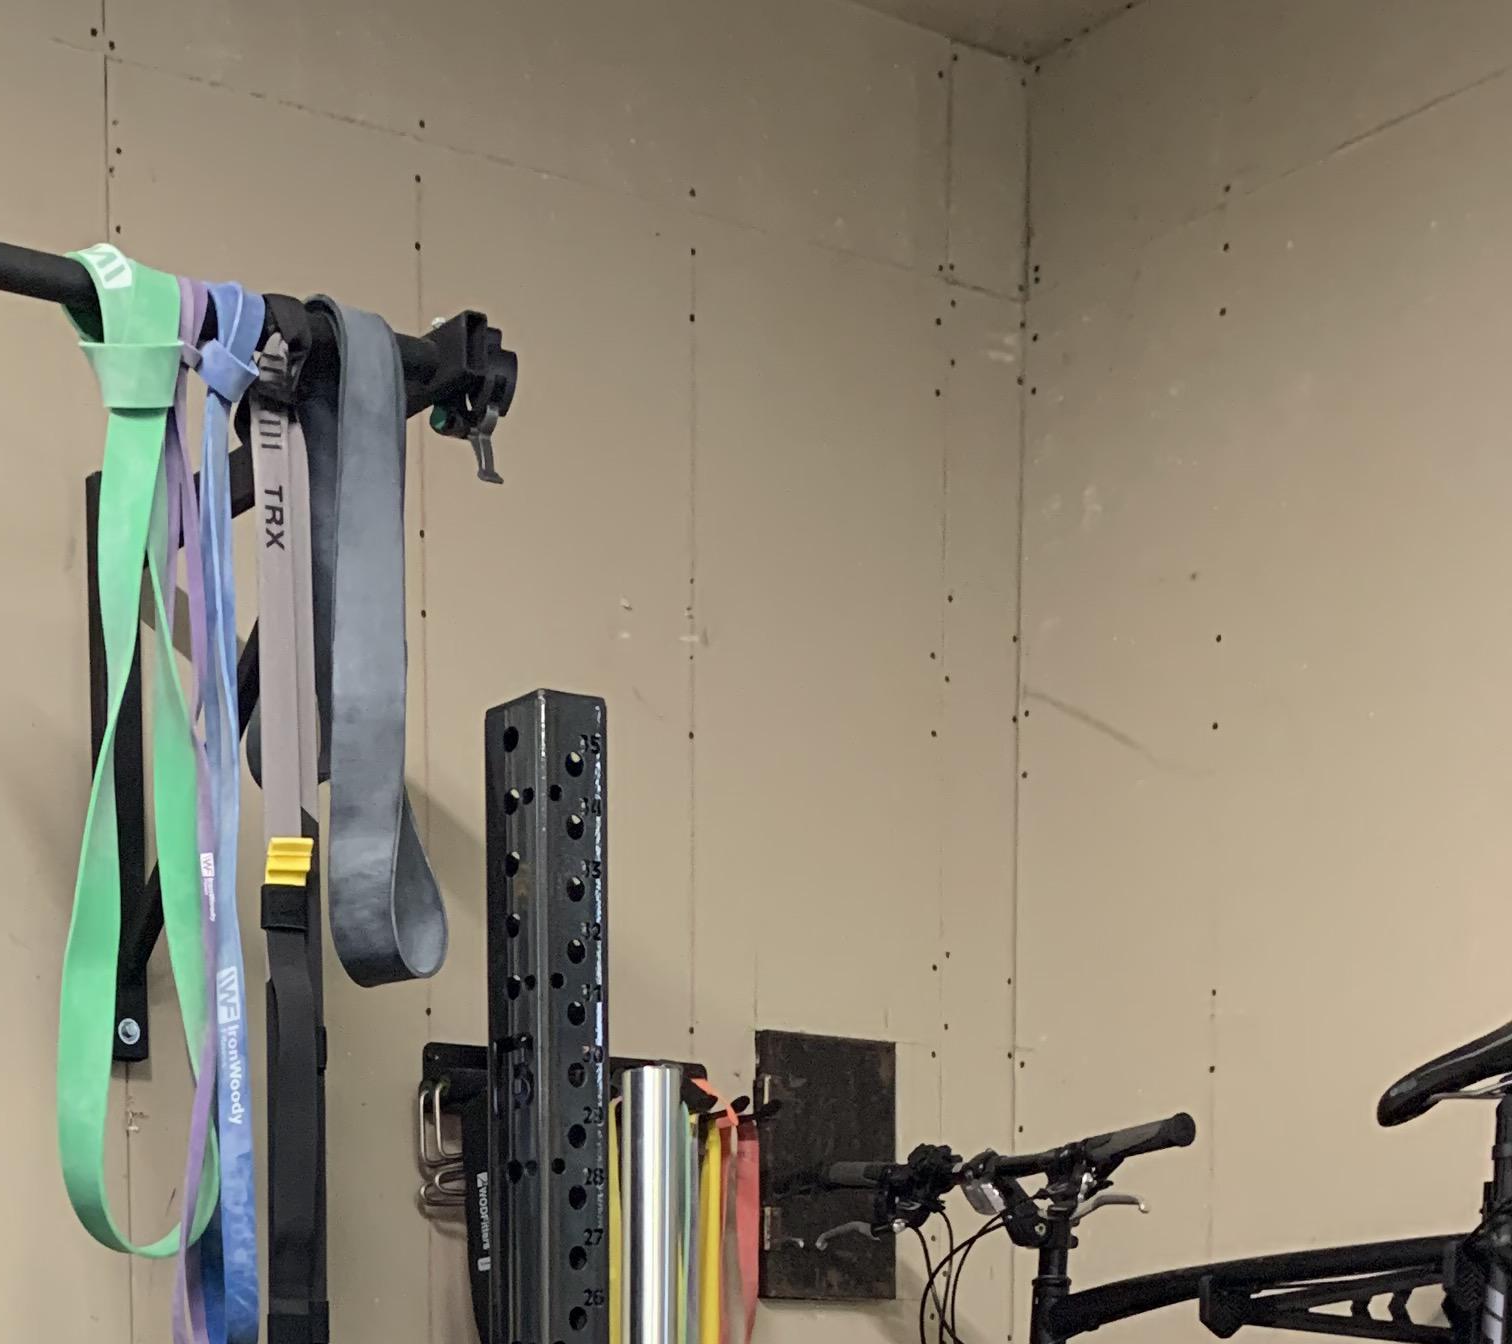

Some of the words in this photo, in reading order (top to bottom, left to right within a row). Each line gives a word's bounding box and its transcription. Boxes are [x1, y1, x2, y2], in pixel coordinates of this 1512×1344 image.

[264, 486, 286, 551] TRX
[227, 1024, 246, 1125] IronWoody
[584, 1228, 604, 1246] 27
[583, 1287, 605, 1306] 26
